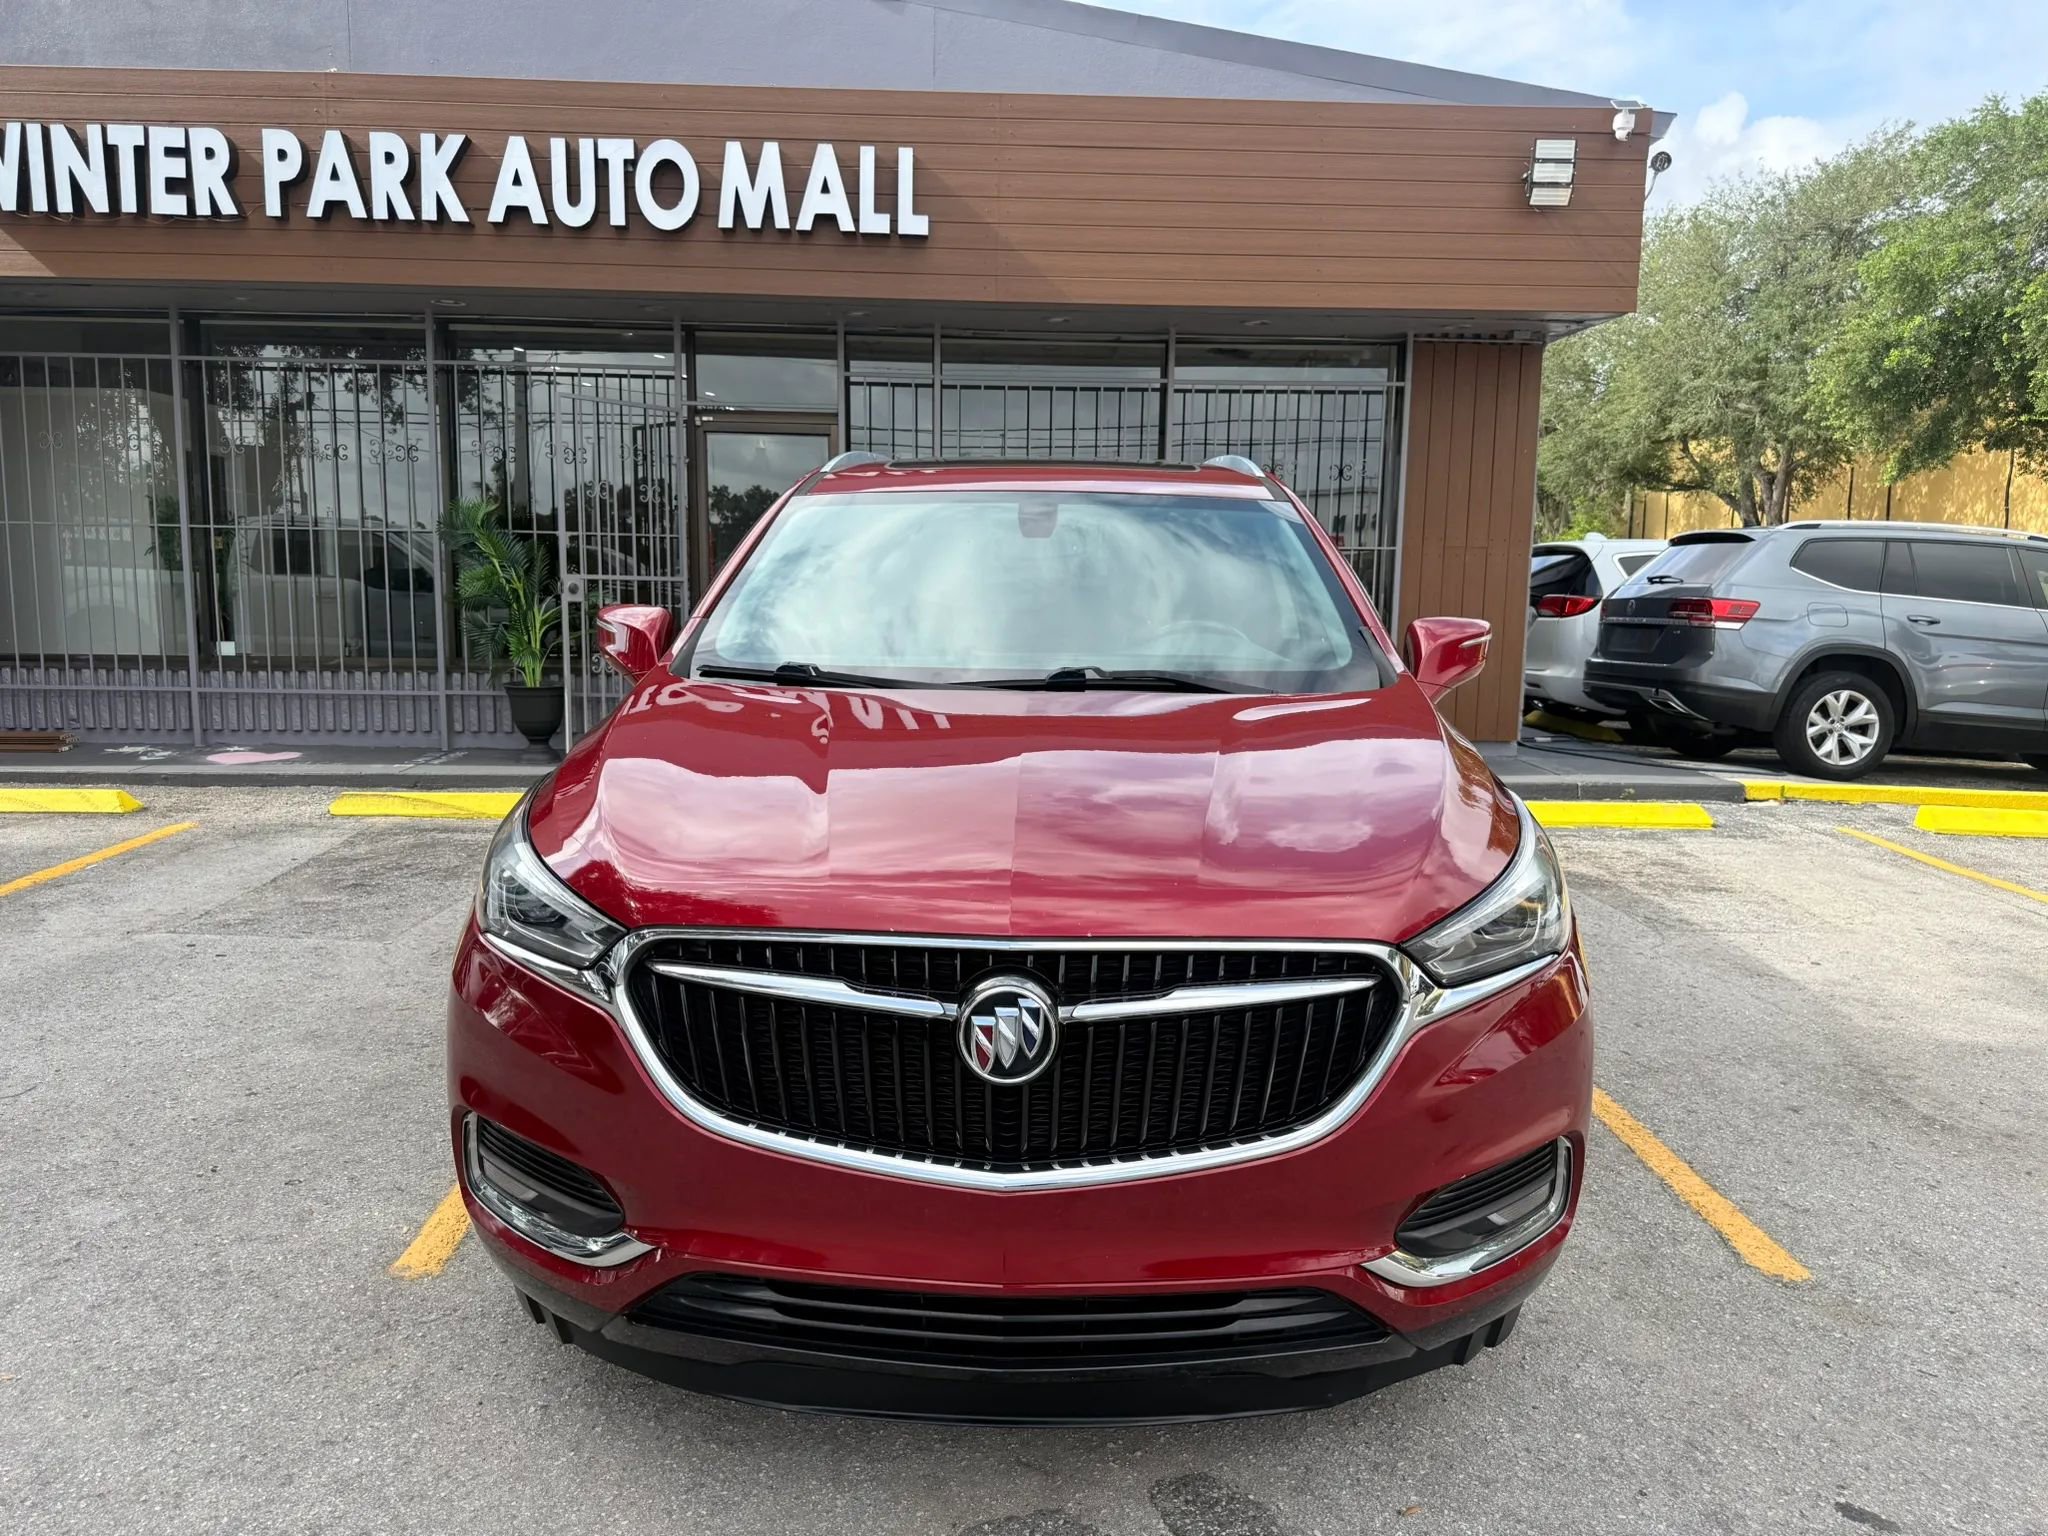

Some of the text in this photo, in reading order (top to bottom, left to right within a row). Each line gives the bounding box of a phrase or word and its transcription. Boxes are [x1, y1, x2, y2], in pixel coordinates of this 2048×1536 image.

[0, 121, 930, 236] INTER PARK AUTO MALL
